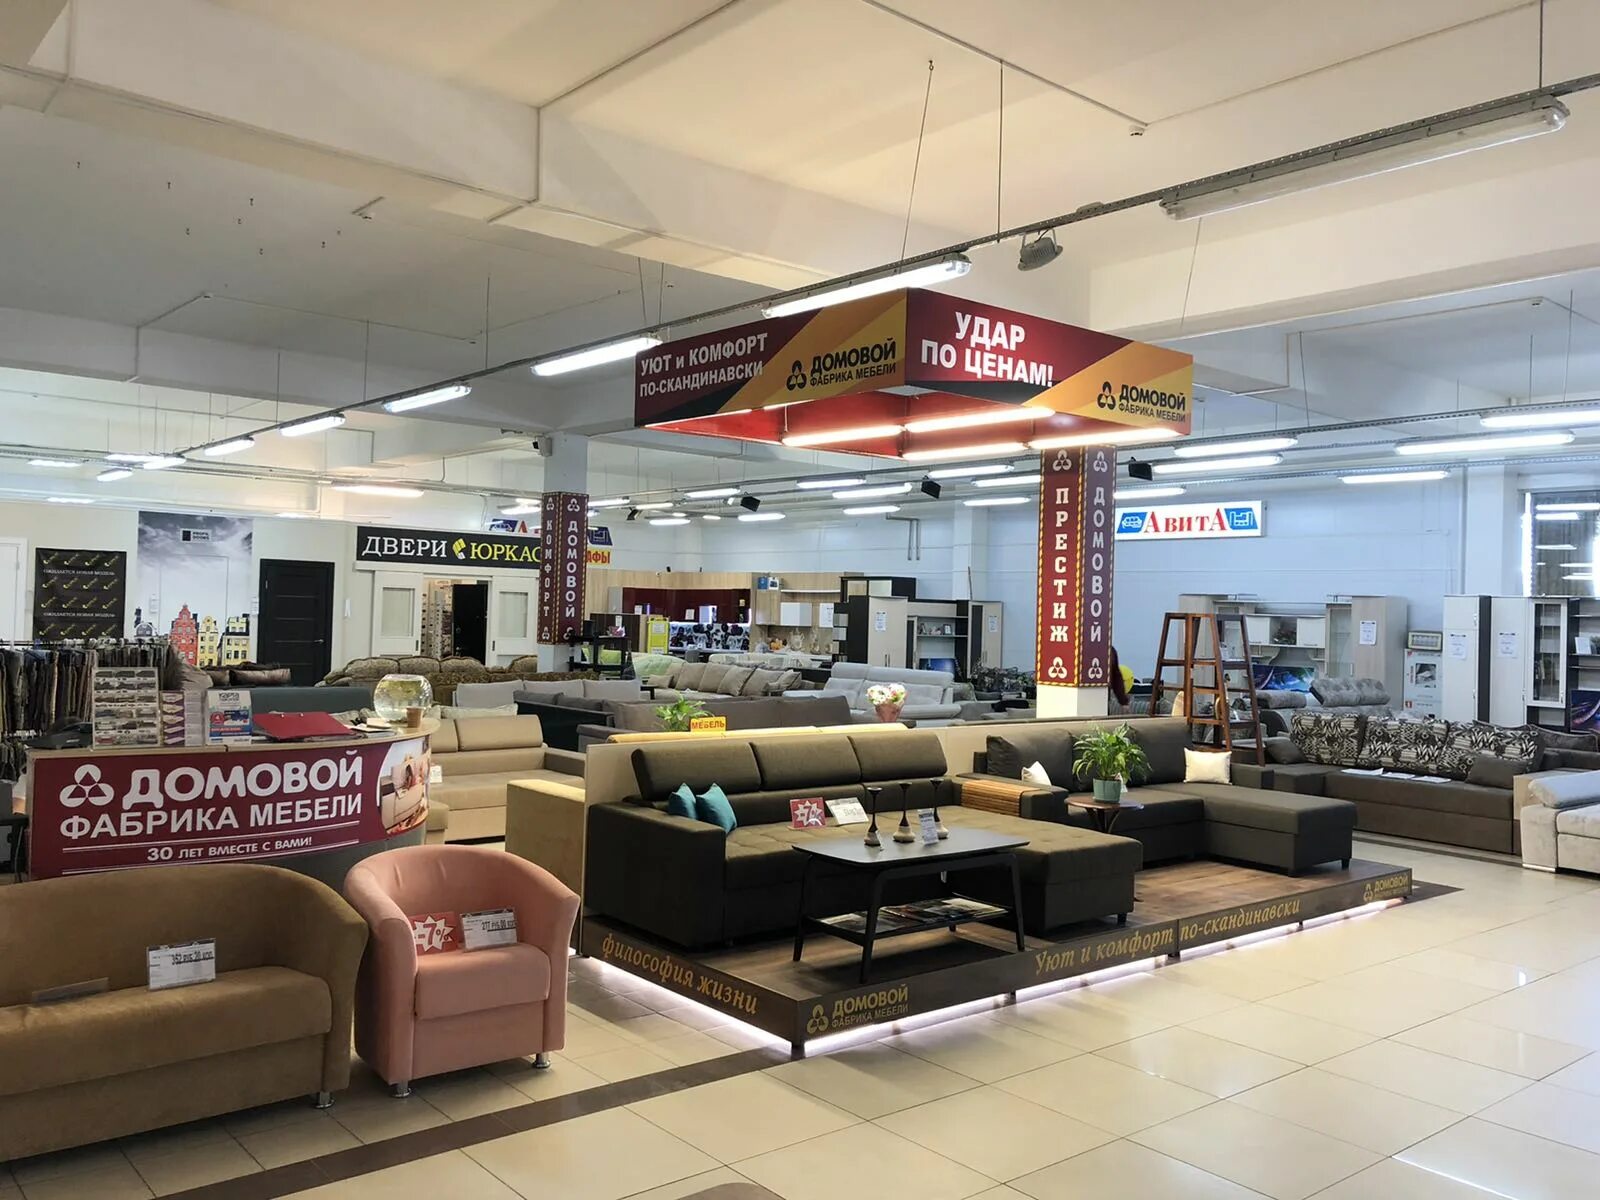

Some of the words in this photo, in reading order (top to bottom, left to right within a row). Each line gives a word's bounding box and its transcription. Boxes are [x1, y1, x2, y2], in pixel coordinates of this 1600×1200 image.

[954, 311, 1025, 351] УДАР
[641, 354, 672, 377] УЮТ
[676, 357, 684, 369] и
[689, 332, 768, 367] КОМФОРТ
[810, 337, 896, 375] ДОМОВОЙ
[921, 339, 957, 369] ПО
[964, 348, 1054, 387] ЦЕНАМ!
[640, 360, 763, 398] ПО-СКАНДИНАВСКИ
[809, 370, 854, 388] ФАБРИКА
[855, 362, 897, 380] МЕБЕЛИ
[1118, 384, 1186, 411] ДОМОВОЙ
[1118, 402, 1155, 419] ФАБРИКА
[1155, 409, 1186, 423] МЕБЕЛИ
[362, 536, 447, 558] ДВЕРИ
[586, 550, 611, 564] АФЫ
[1049, 487, 1069, 643] ПРЕСТИЖ
[1090, 486, 1106, 643] ДОМОВОЙ
[543, 520, 555, 617] КОМФОРТ
[564, 519, 579, 618] ДОМОВОЙ
[691, 720, 725, 729] МЕБЕЛЬ
[122, 749, 363, 810] ДОМОВОЙ
[60, 806, 240, 840] ФАБРИКА
[249, 793, 363, 828] МЕБЕЛИ
[147, 846, 174, 861] 30
[178, 847, 204, 860] ЛЕТ
[208, 843, 259, 858] ВМЕСТЕ
[262, 841, 271, 851] С
[275, 836, 312, 850] ВАМИ!
[417, 923, 451, 945] -7%
[1035, 951, 1075, 977] Уют
[1081, 948, 1091, 965] и
[1096, 926, 1175, 963] комфорт
[1179, 898, 1301, 944] по-скандинавски
[602, 932, 694, 988] философия
[697, 974, 759, 1016] жизни
[831, 1010, 874, 1030] ФАБРИКА
[875, 1003, 910, 1021] МЕБЕЛИ
[832, 983, 910, 1018] ДОМОВОЙ
